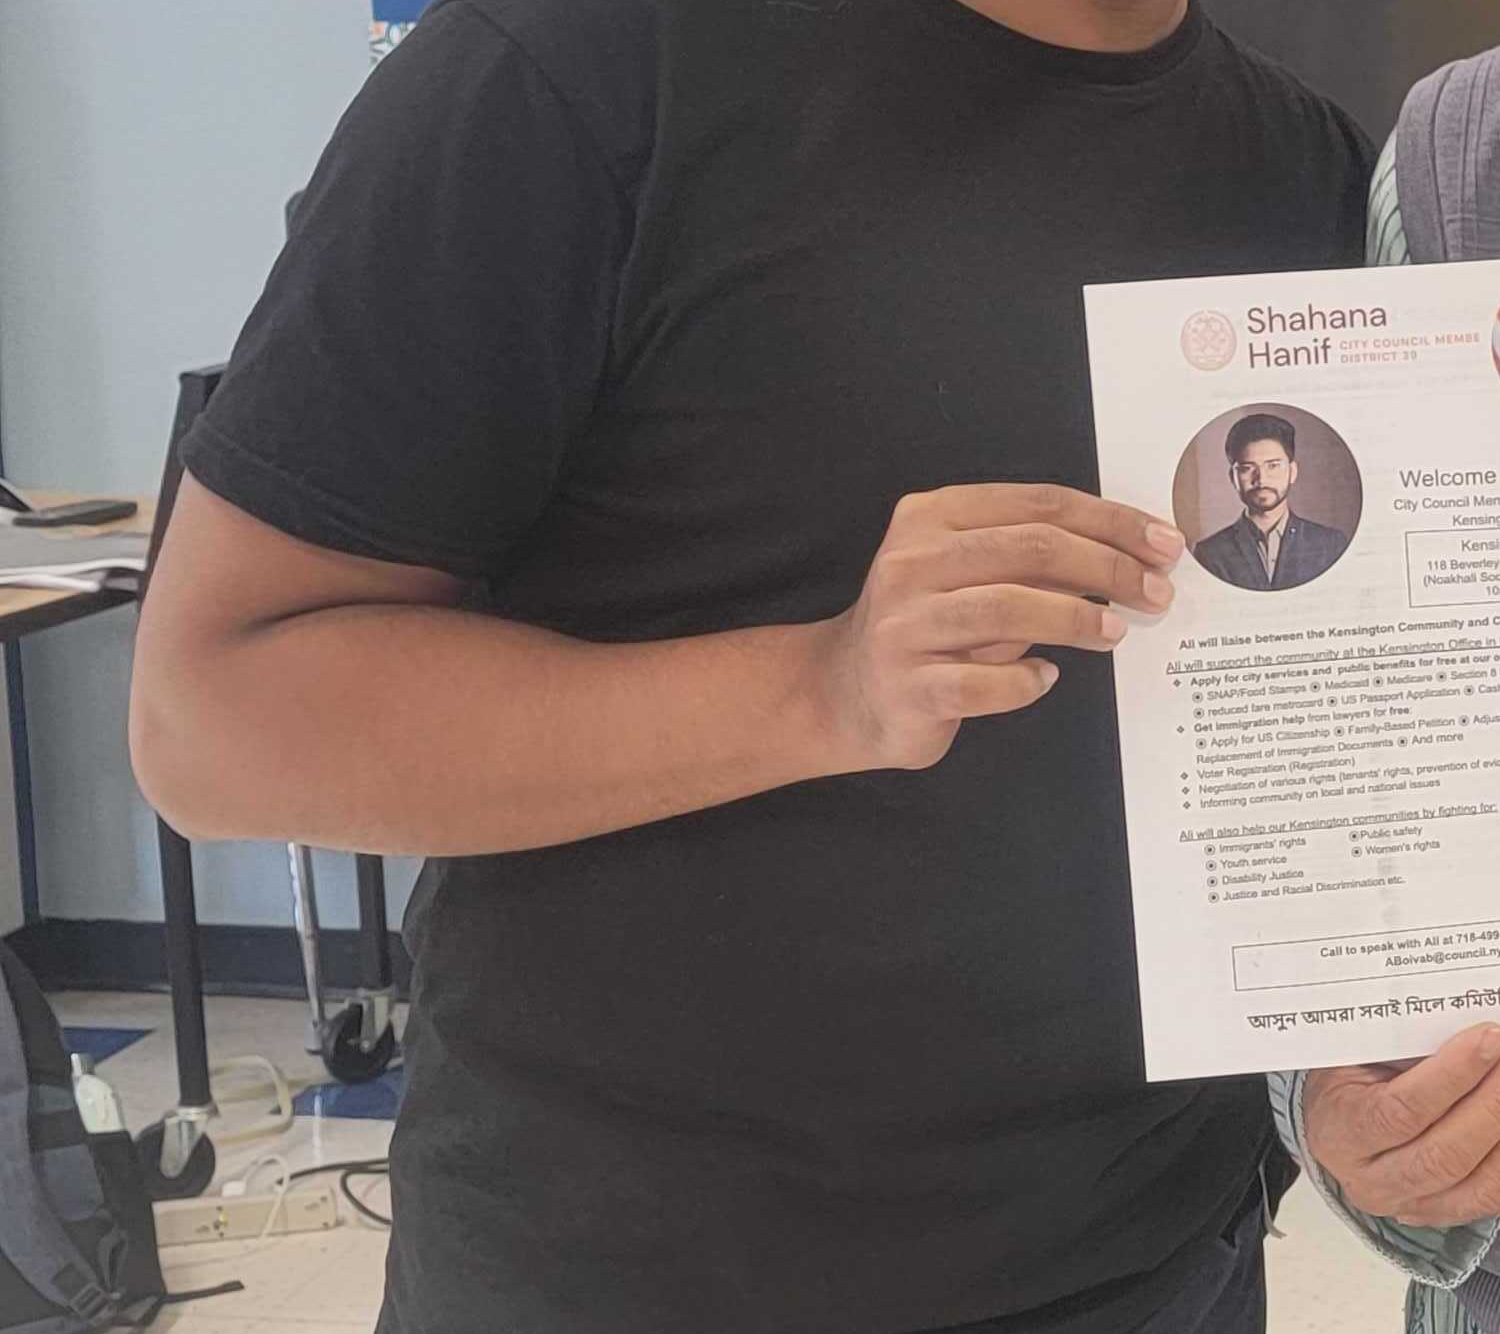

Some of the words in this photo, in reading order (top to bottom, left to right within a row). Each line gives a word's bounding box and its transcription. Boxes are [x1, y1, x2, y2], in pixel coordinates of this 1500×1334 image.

[1247, 304, 1387, 334] Shahana
[1249, 337, 1331, 368] Hanif
[1339, 339, 1369, 350] CITY
[1372, 336, 1430, 349] COUNCIL
[1340, 351, 1398, 364] DISTRICT
[1400, 470, 1496, 488] Welcome
[1394, 497, 1417, 512] City
[1422, 494, 1469, 509] Council
[1428, 559, 1446, 570] 118
[1450, 558, 1499, 570] Beverley
[1199, 636, 1217, 647] will
[1221, 634, 1251, 646] liaise
[1255, 632, 1303, 643] between
[1307, 628, 1324, 639] the
[1329, 623, 1394, 637] Kensington
[1398, 618, 1464, 631] Community
[1468, 616, 1489, 627] and
[1321, 945, 1342, 957] Call
[1346, 944, 1356, 955] to
[1361, 940, 1393, 955] speak
[1397, 937, 1420, 949] with
[1443, 933, 1452, 944] at
